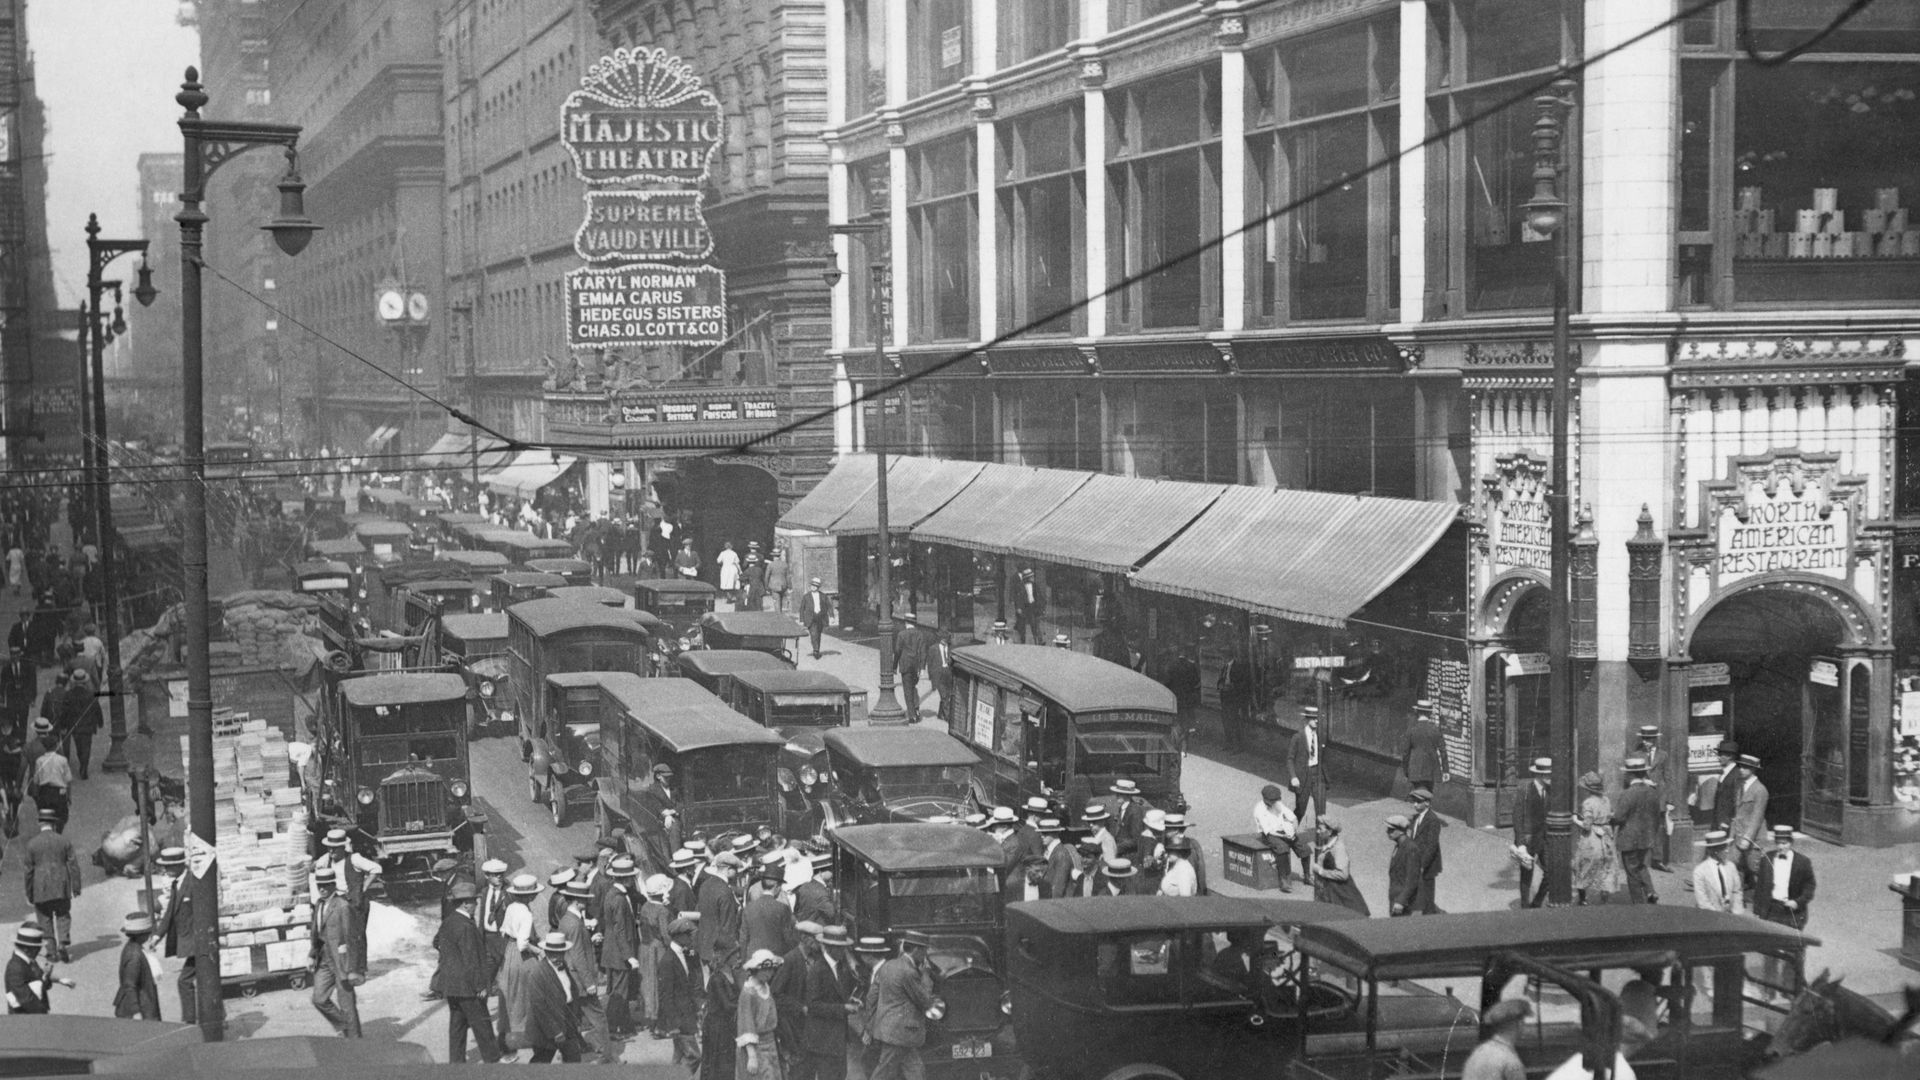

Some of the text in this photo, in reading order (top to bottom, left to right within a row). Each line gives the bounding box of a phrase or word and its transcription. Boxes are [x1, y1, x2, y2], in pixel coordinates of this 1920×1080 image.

[569, 112, 719, 143] MAJESTIC
[580, 148, 705, 170] THEATRE
[593, 204, 695, 223] SUPREME
[585, 228, 705, 250] VAUDEVILLE
[572, 274, 696, 290] KARYL NORMAN
[578, 290, 684, 306] EMMA CARUS
[580, 305, 722, 322] HEDEGUS SISTERS
[1750, 502, 1816, 524] NORTH
[1730, 525, 1836, 549] AMERICAN
[1720, 547, 1846, 574] RESTAURANT
[1304, 657, 1331, 668] STATE
